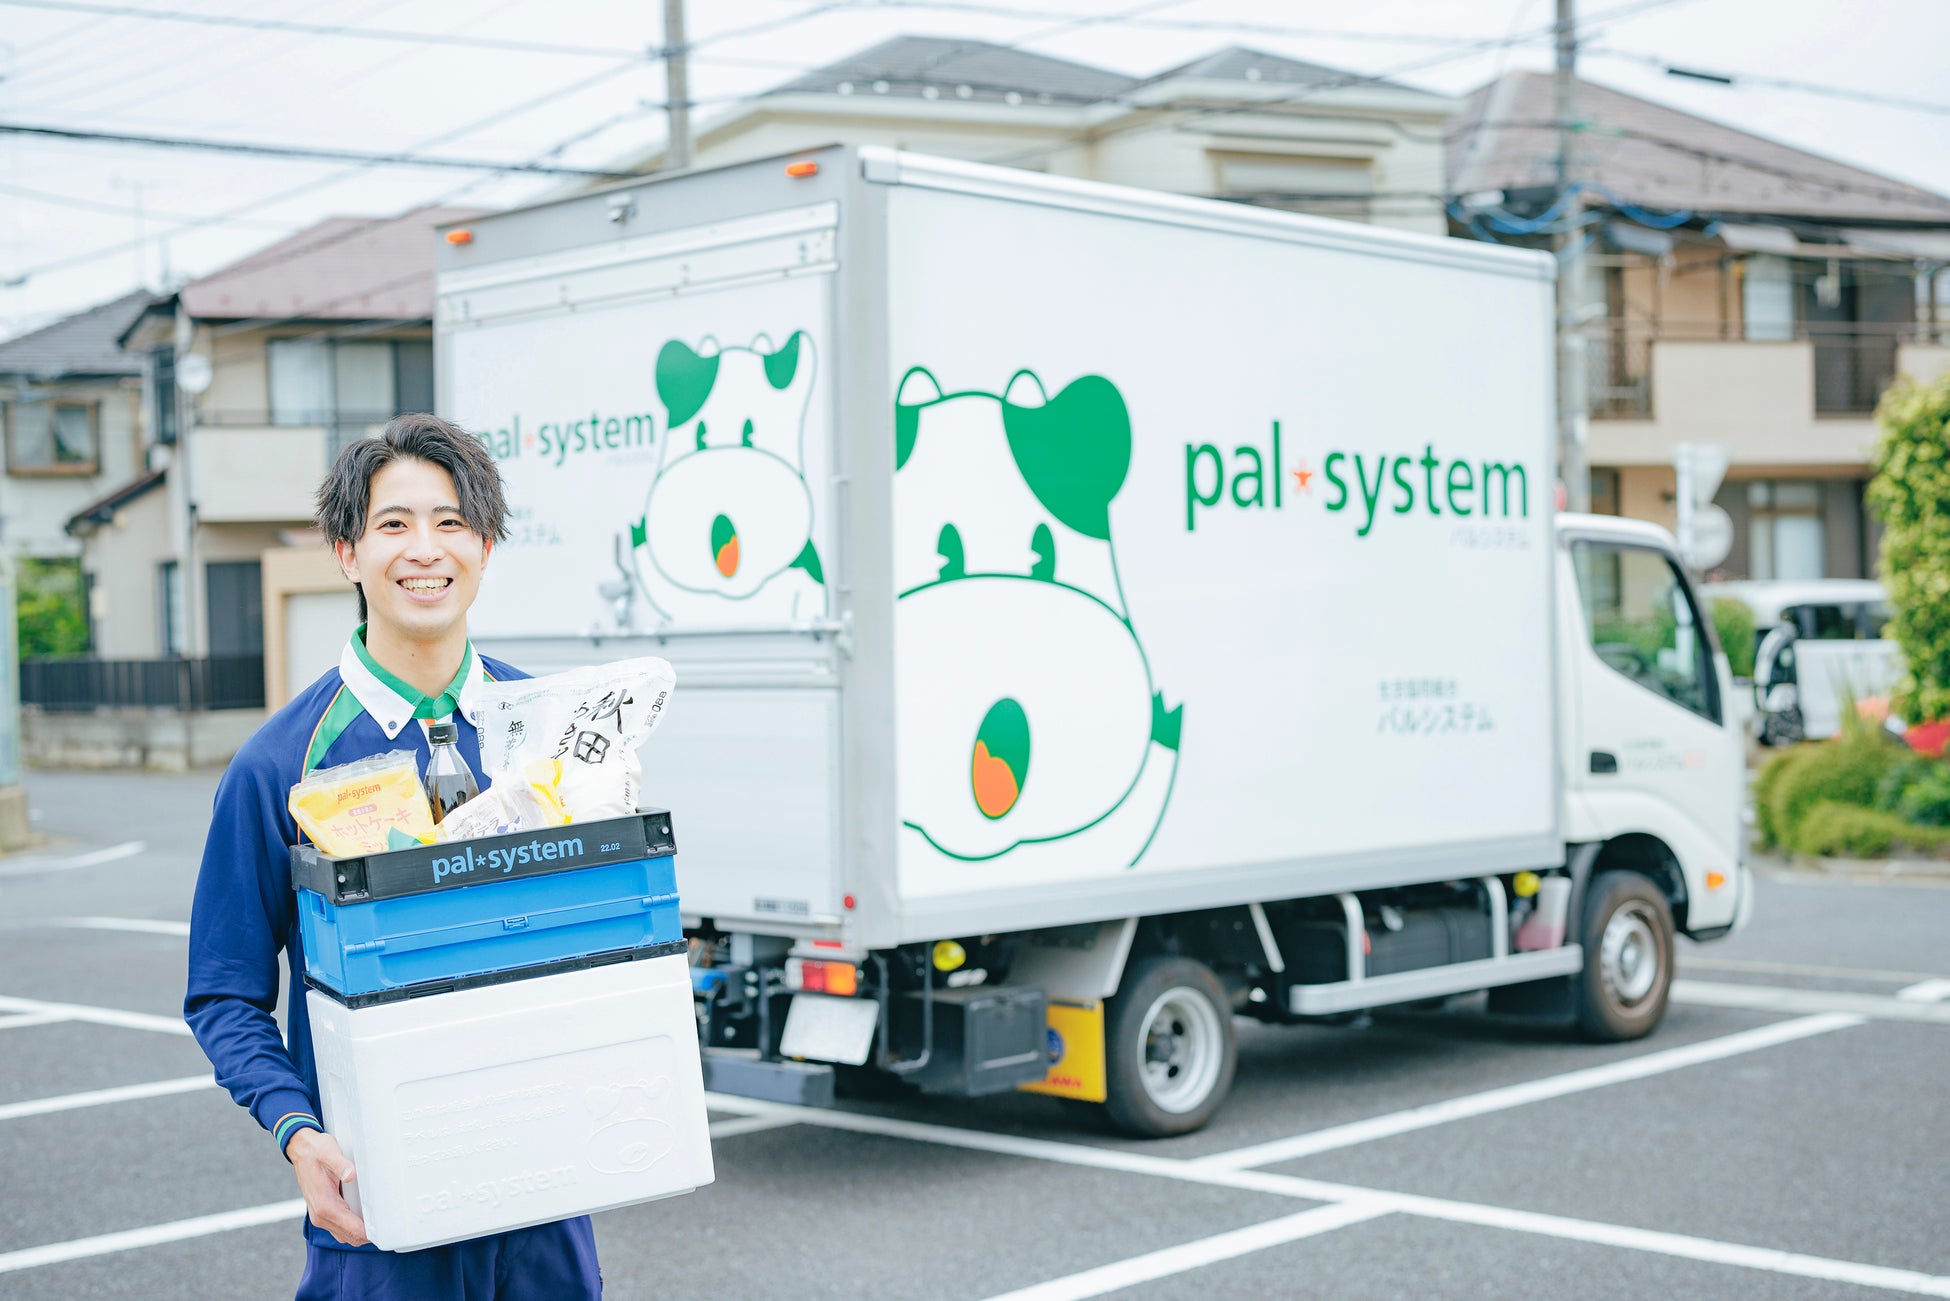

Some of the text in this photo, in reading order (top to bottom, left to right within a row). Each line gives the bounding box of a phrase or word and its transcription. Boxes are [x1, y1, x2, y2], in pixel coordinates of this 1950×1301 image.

[539, 412, 654, 467] system
[1185, 420, 1528, 538] pal system
[337, 783, 381, 804] pal system
[331, 808, 413, 837] ホットケーキ
[431, 837, 584, 883] pal system
[600, 843, 621, 853] 22.02
